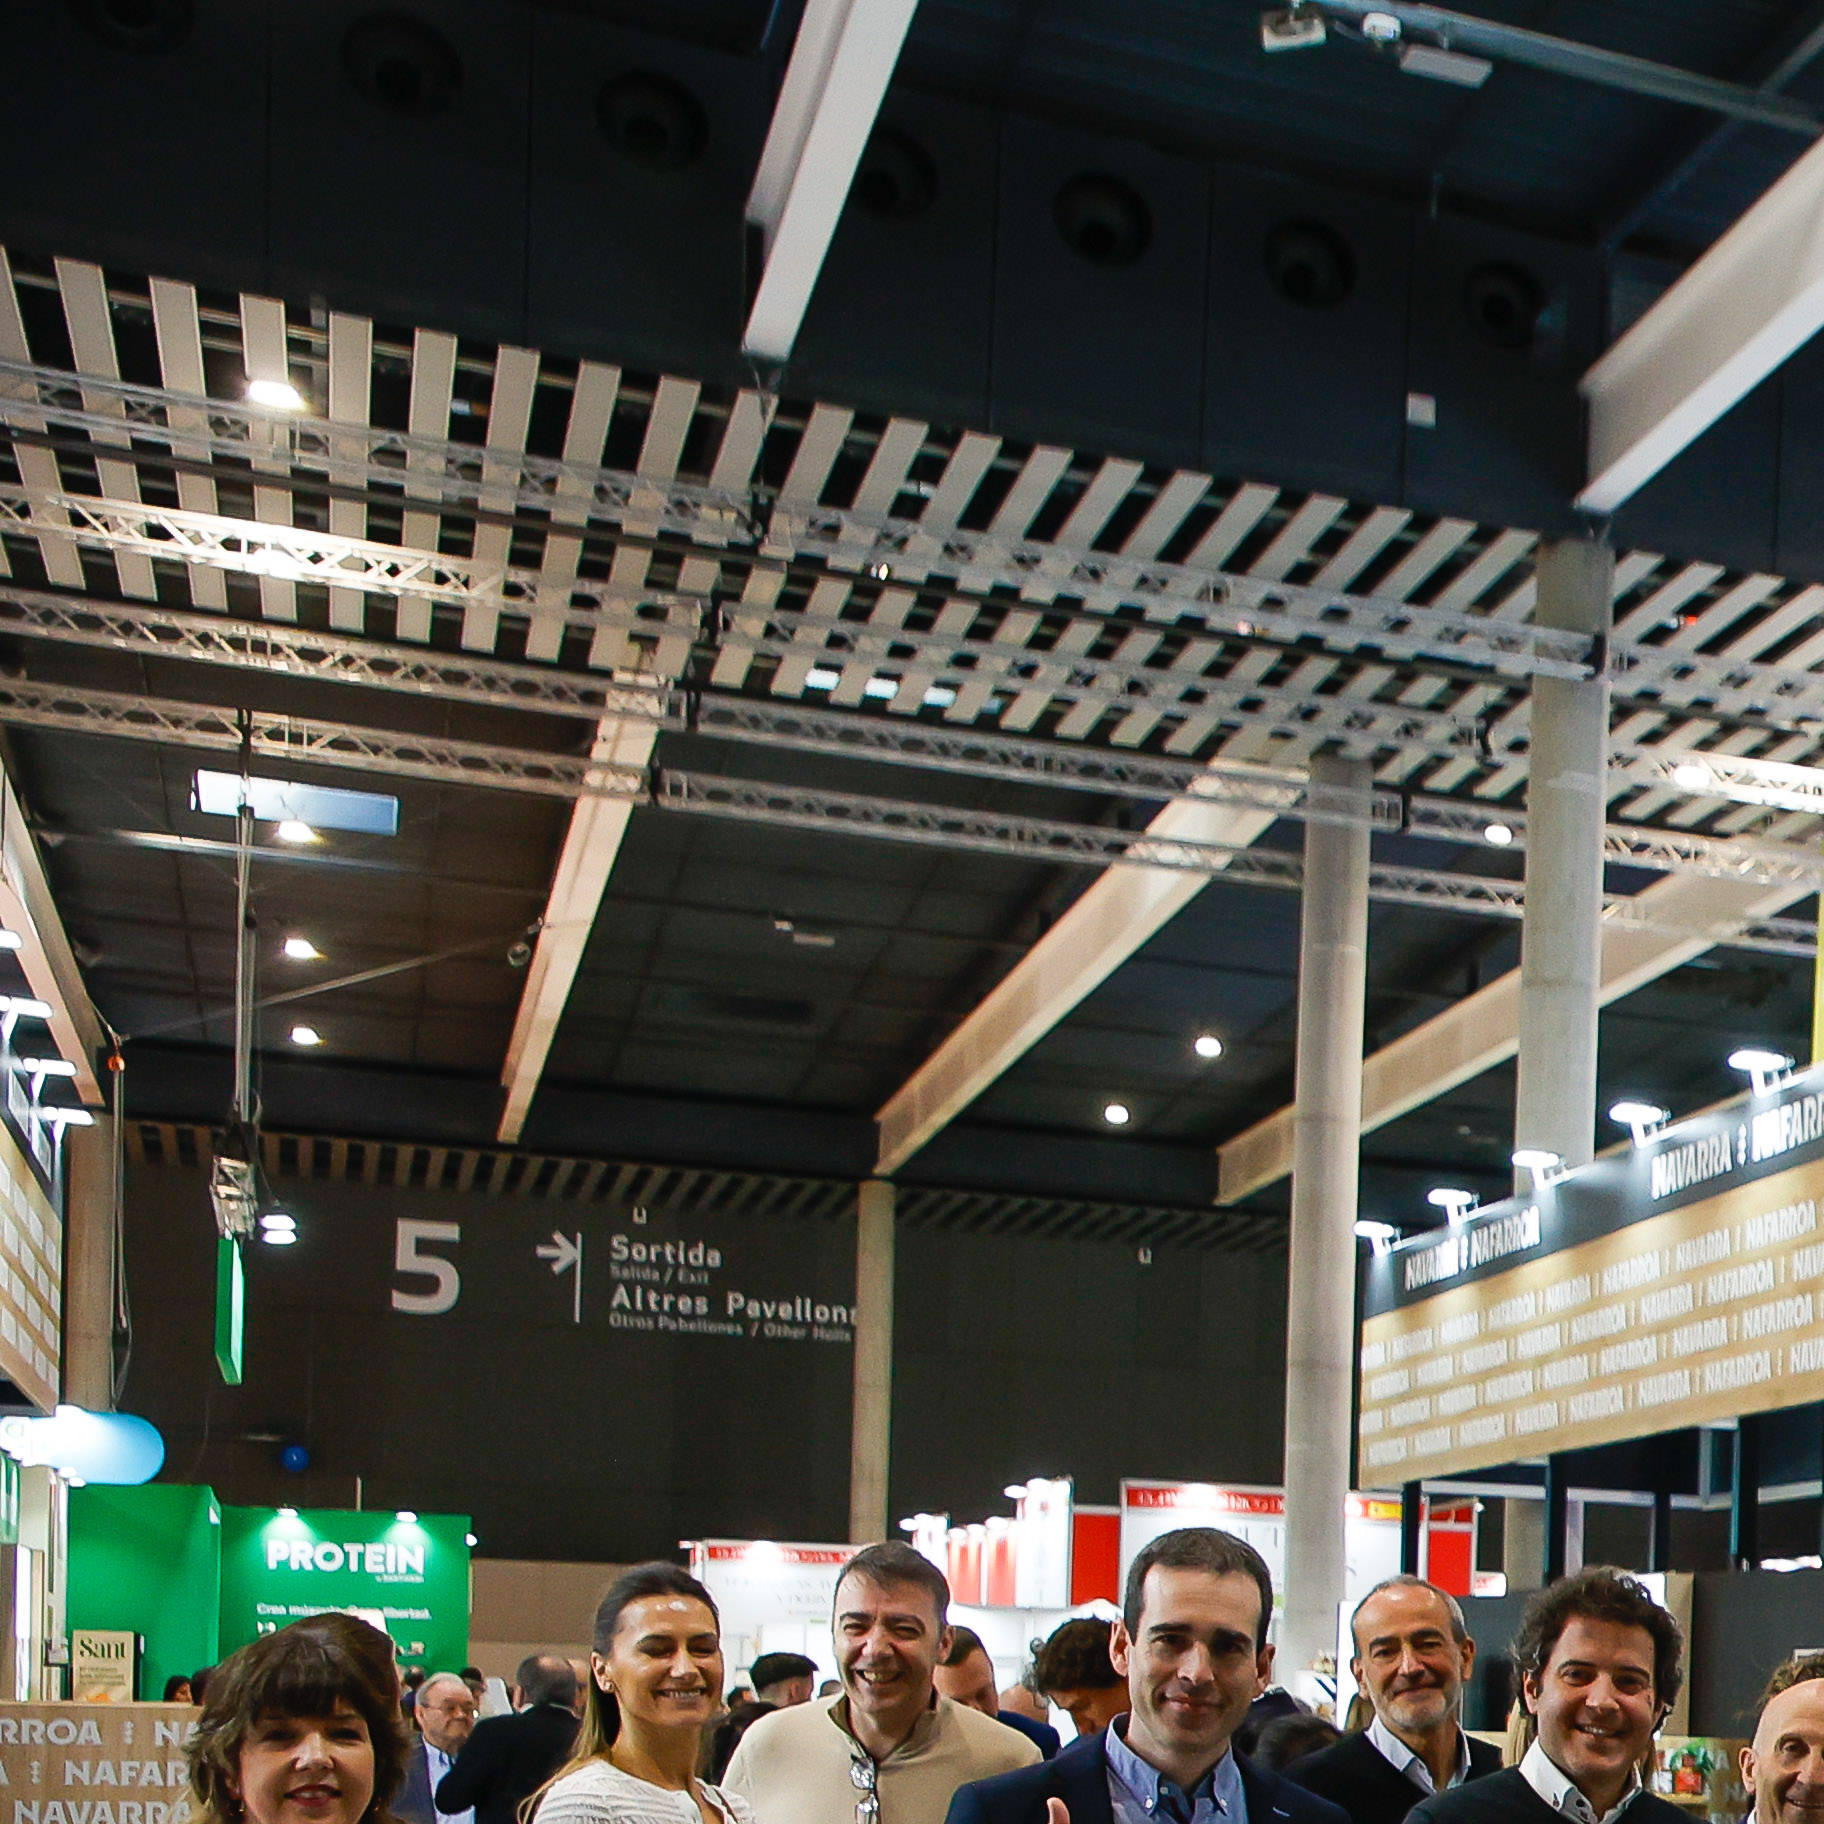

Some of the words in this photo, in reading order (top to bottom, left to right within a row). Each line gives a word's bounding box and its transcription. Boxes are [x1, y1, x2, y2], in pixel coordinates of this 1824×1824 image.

[1651, 1130, 1733, 1200] NAVARRA
[391, 1217, 461, 1316] 5
[610, 1233, 722, 1268] Sortida
[610, 1283, 709, 1315] Altres
[266, 1539, 425, 1574] PROTEIN
